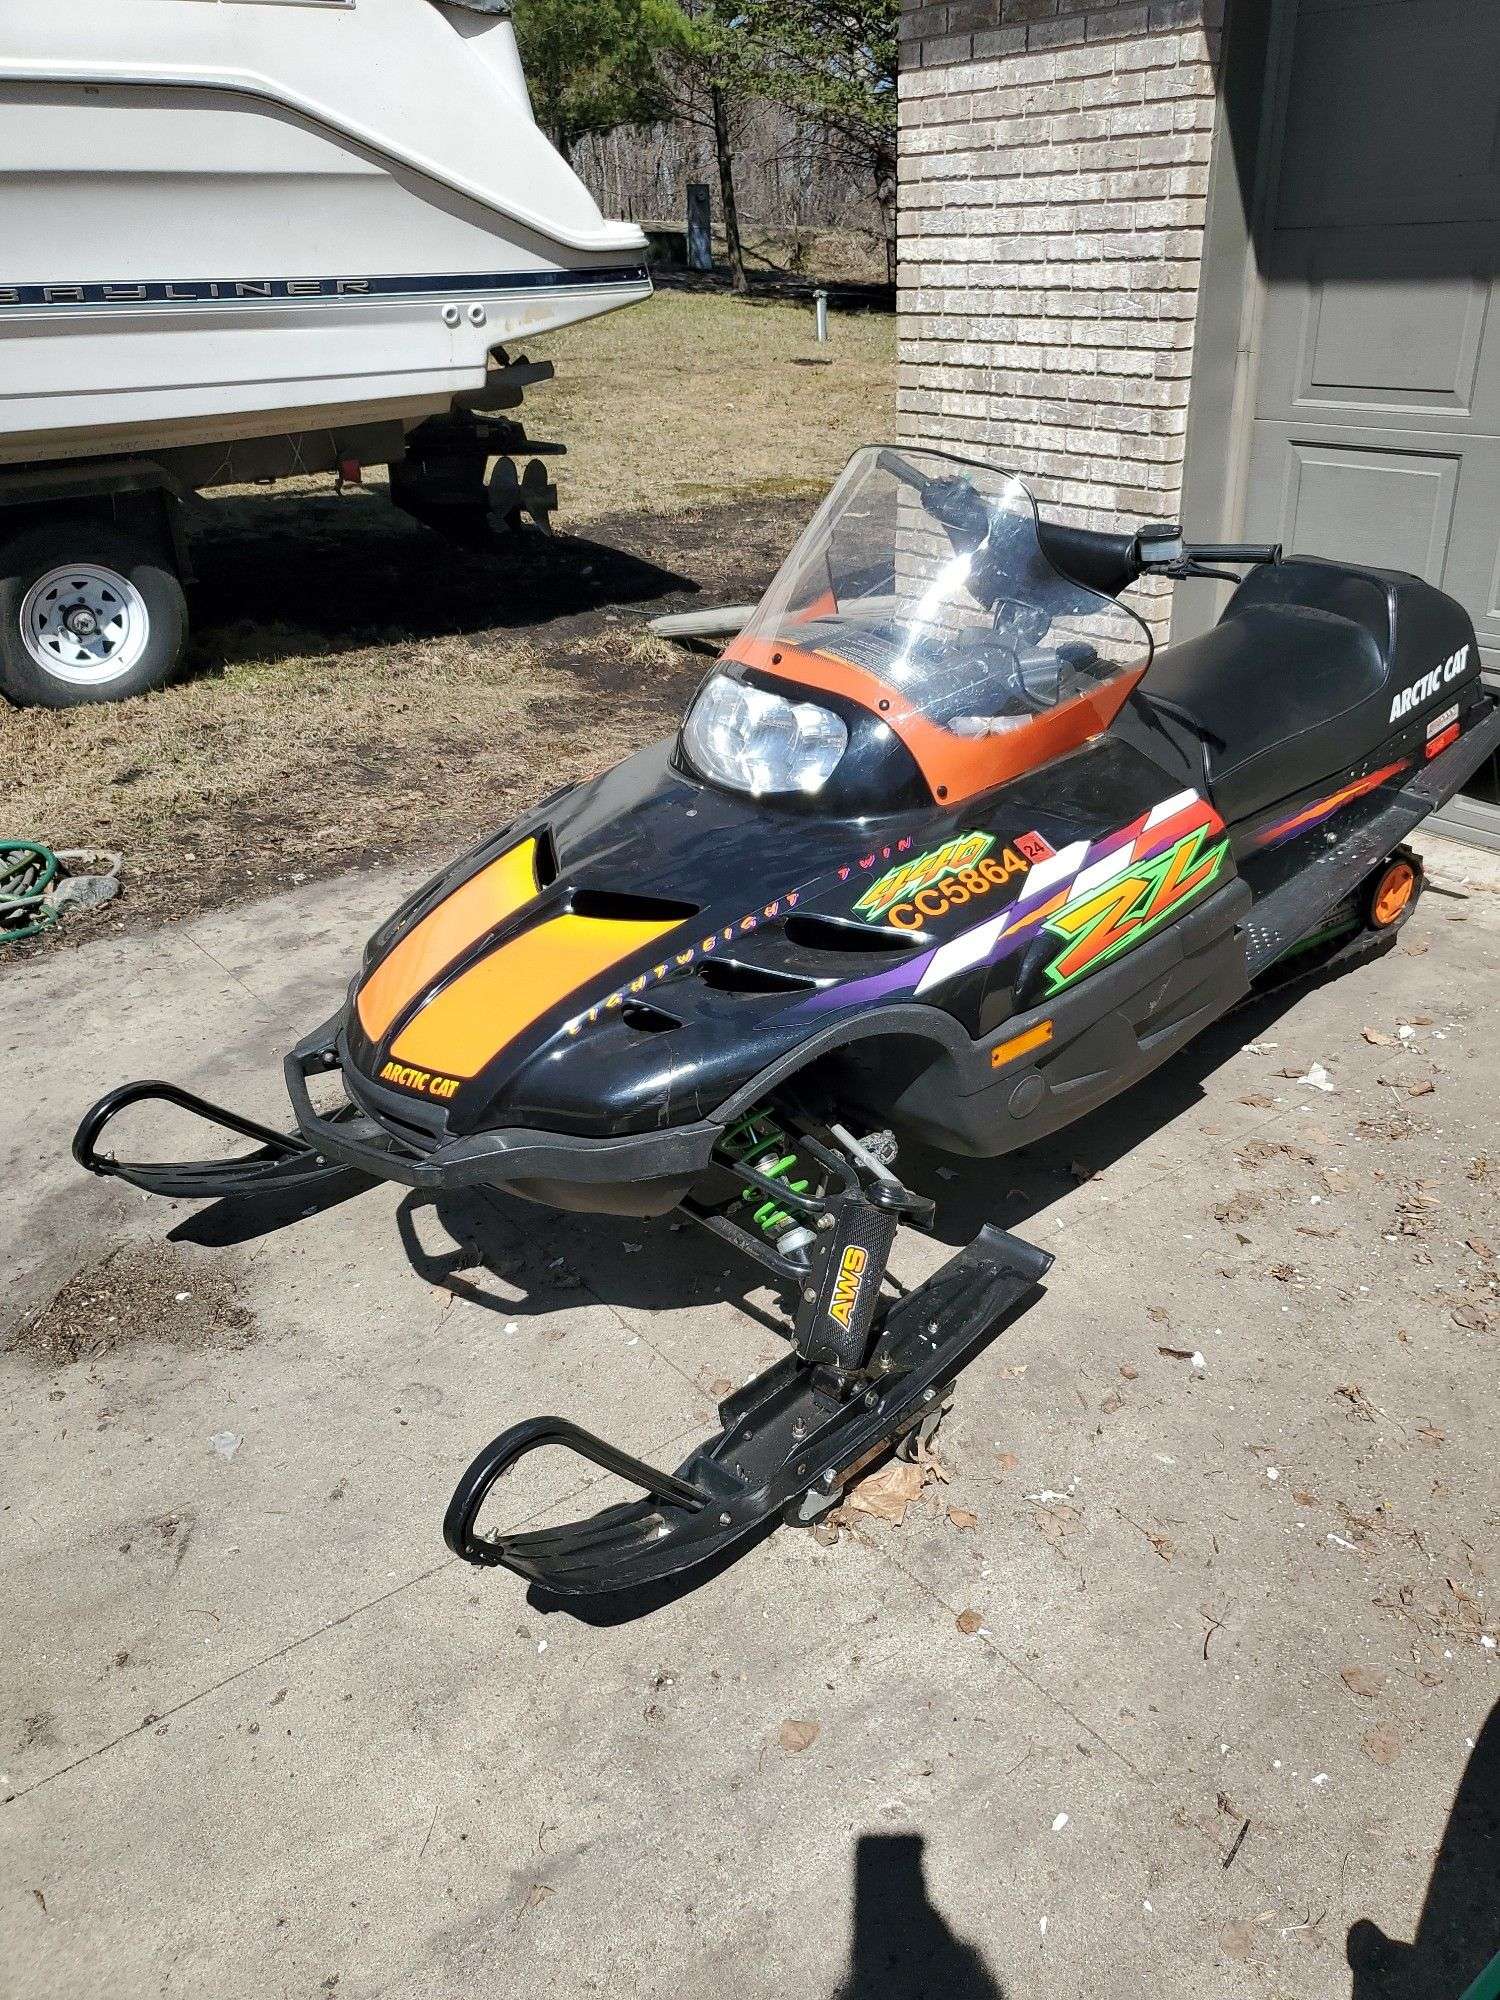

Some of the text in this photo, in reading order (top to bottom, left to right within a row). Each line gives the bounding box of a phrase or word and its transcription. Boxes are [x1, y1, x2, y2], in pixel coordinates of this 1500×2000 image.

[1389, 665, 1442, 723] ARCTIC
[1444, 644, 1470, 682] CAT
[837, 835, 912, 880] TWIN
[855, 832, 995, 920] 440
[888, 847, 1029, 930] CC5864
[1023, 842, 1045, 857] 24
[379, 1061, 460, 1098] ARCTIC CAT
[828, 1245, 868, 1331] AWS
